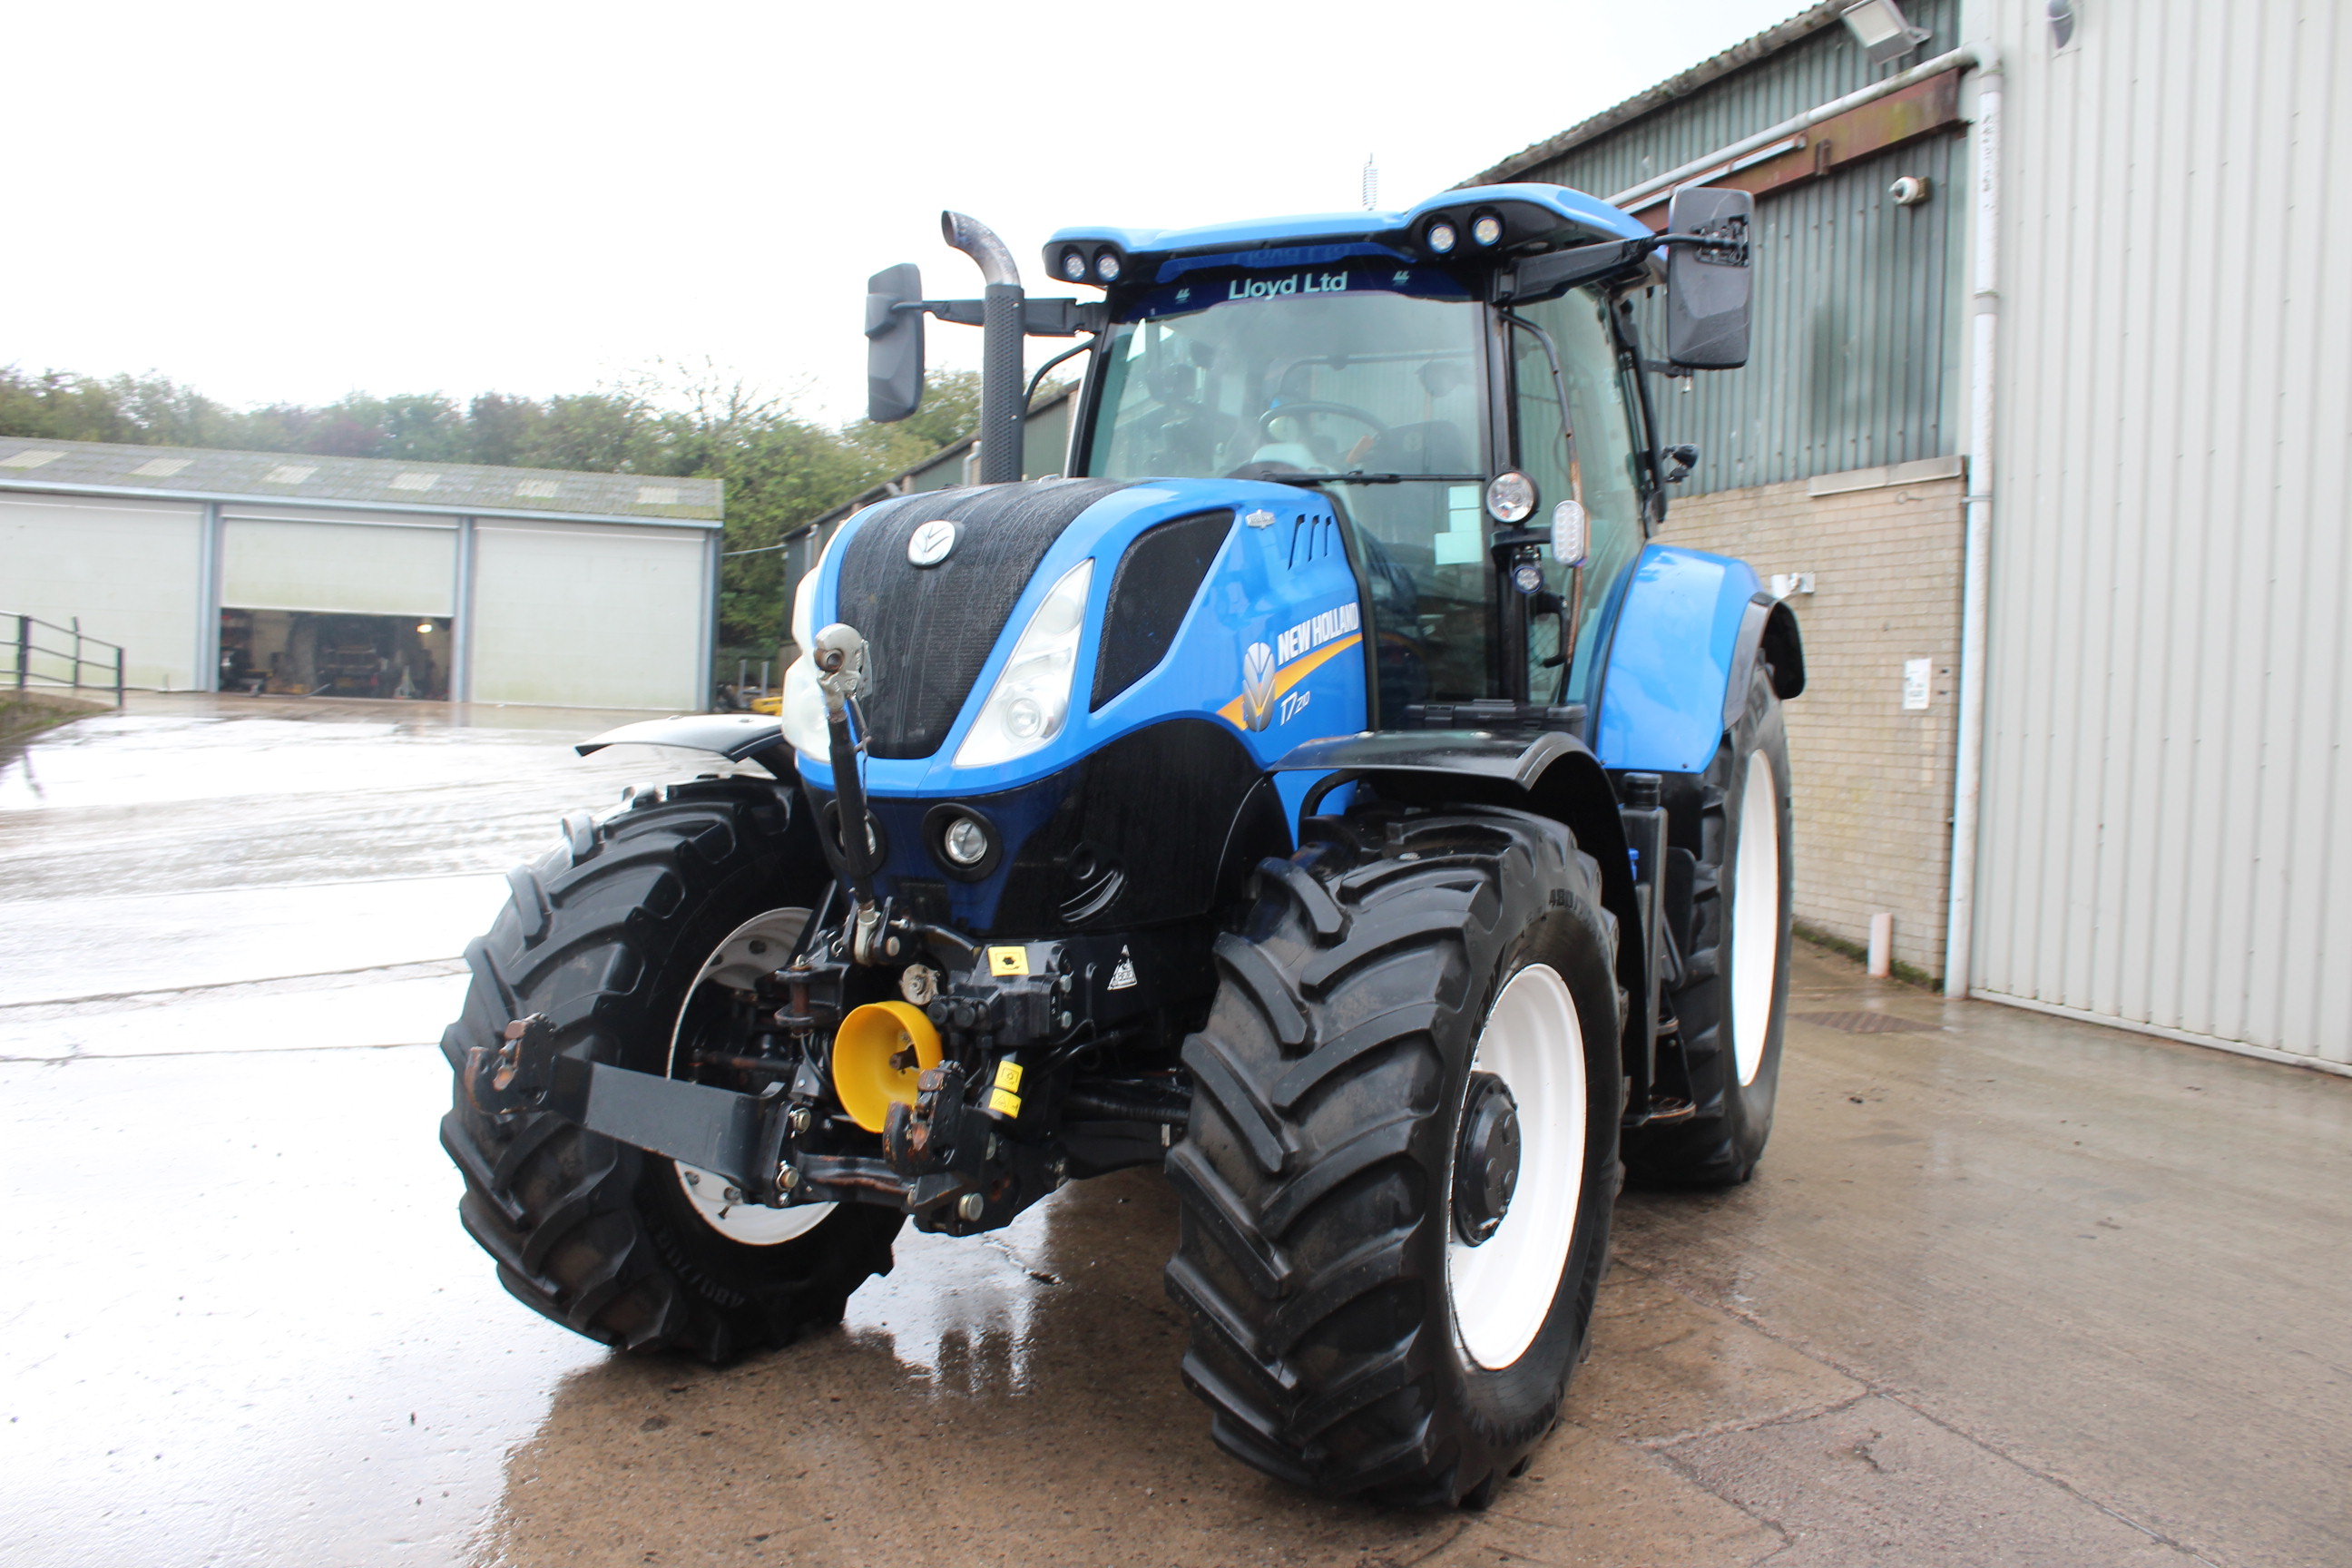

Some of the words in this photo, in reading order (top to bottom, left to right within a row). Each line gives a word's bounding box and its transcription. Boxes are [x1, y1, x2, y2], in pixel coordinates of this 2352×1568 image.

[1229, 274, 1298, 300] Lloyd
[1304, 270, 1348, 292] Ltd
[1278, 619, 1311, 666] NEW
[1312, 602, 1359, 648] HOLLAND
